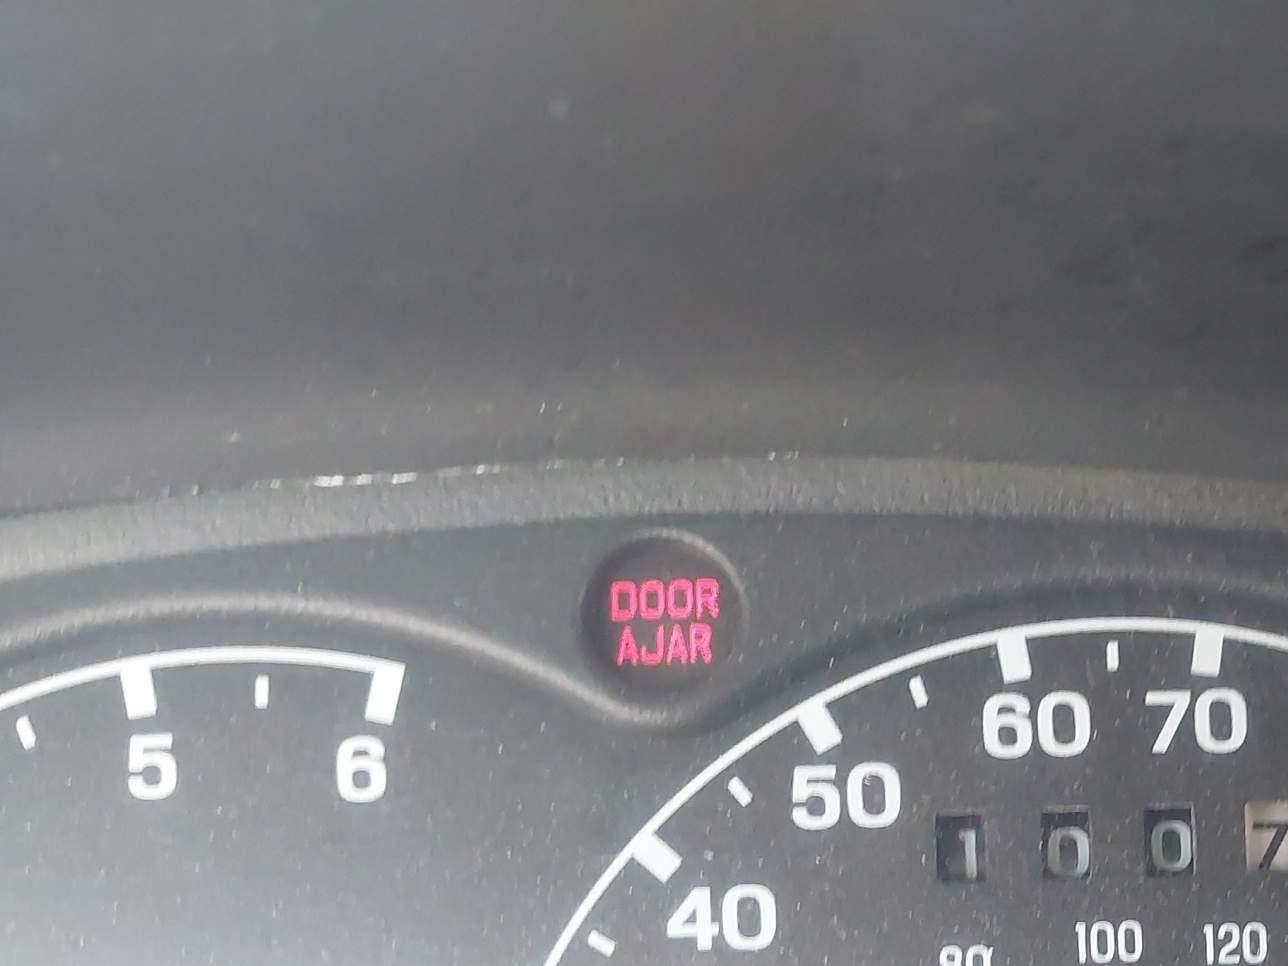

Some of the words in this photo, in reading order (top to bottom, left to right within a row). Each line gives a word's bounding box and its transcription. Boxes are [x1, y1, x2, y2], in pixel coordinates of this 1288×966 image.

[609, 579, 721, 622] DOOR
[616, 622, 713, 666] AJAR
[982, 691, 1092, 758] 60
[1145, 688, 1248, 754] 70
[127, 733, 178, 801] 5
[335, 736, 388, 803] 6
[790, 762, 902, 830] 50
[666, 883, 777, 952] 40
[1074, 920, 1144, 964] 100
[1203, 924, 1269, 966] 120
